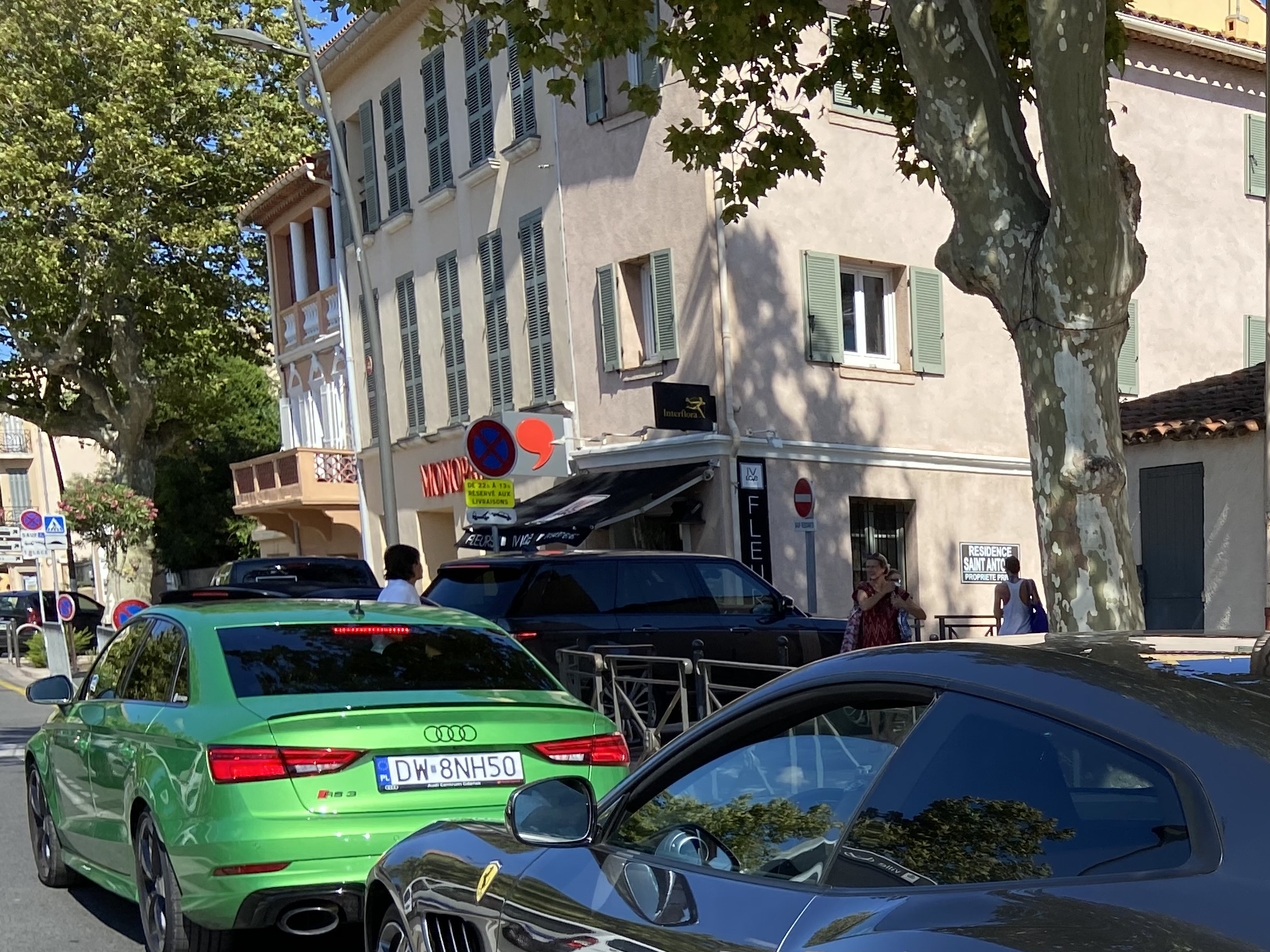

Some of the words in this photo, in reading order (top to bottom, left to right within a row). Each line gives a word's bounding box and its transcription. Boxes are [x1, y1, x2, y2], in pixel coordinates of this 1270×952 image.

[663, 408, 698, 419] Interflora
[419, 456, 484, 498] MONOP
[968, 545, 1013, 558] RESIDENCE
[963, 556, 985, 572] SAINT
[986, 557, 1007, 573] ANTO
[964, 573, 996, 582] PROPRIETE
[395, 758, 429, 782] DW
[439, 755, 517, 780] 8NH50
